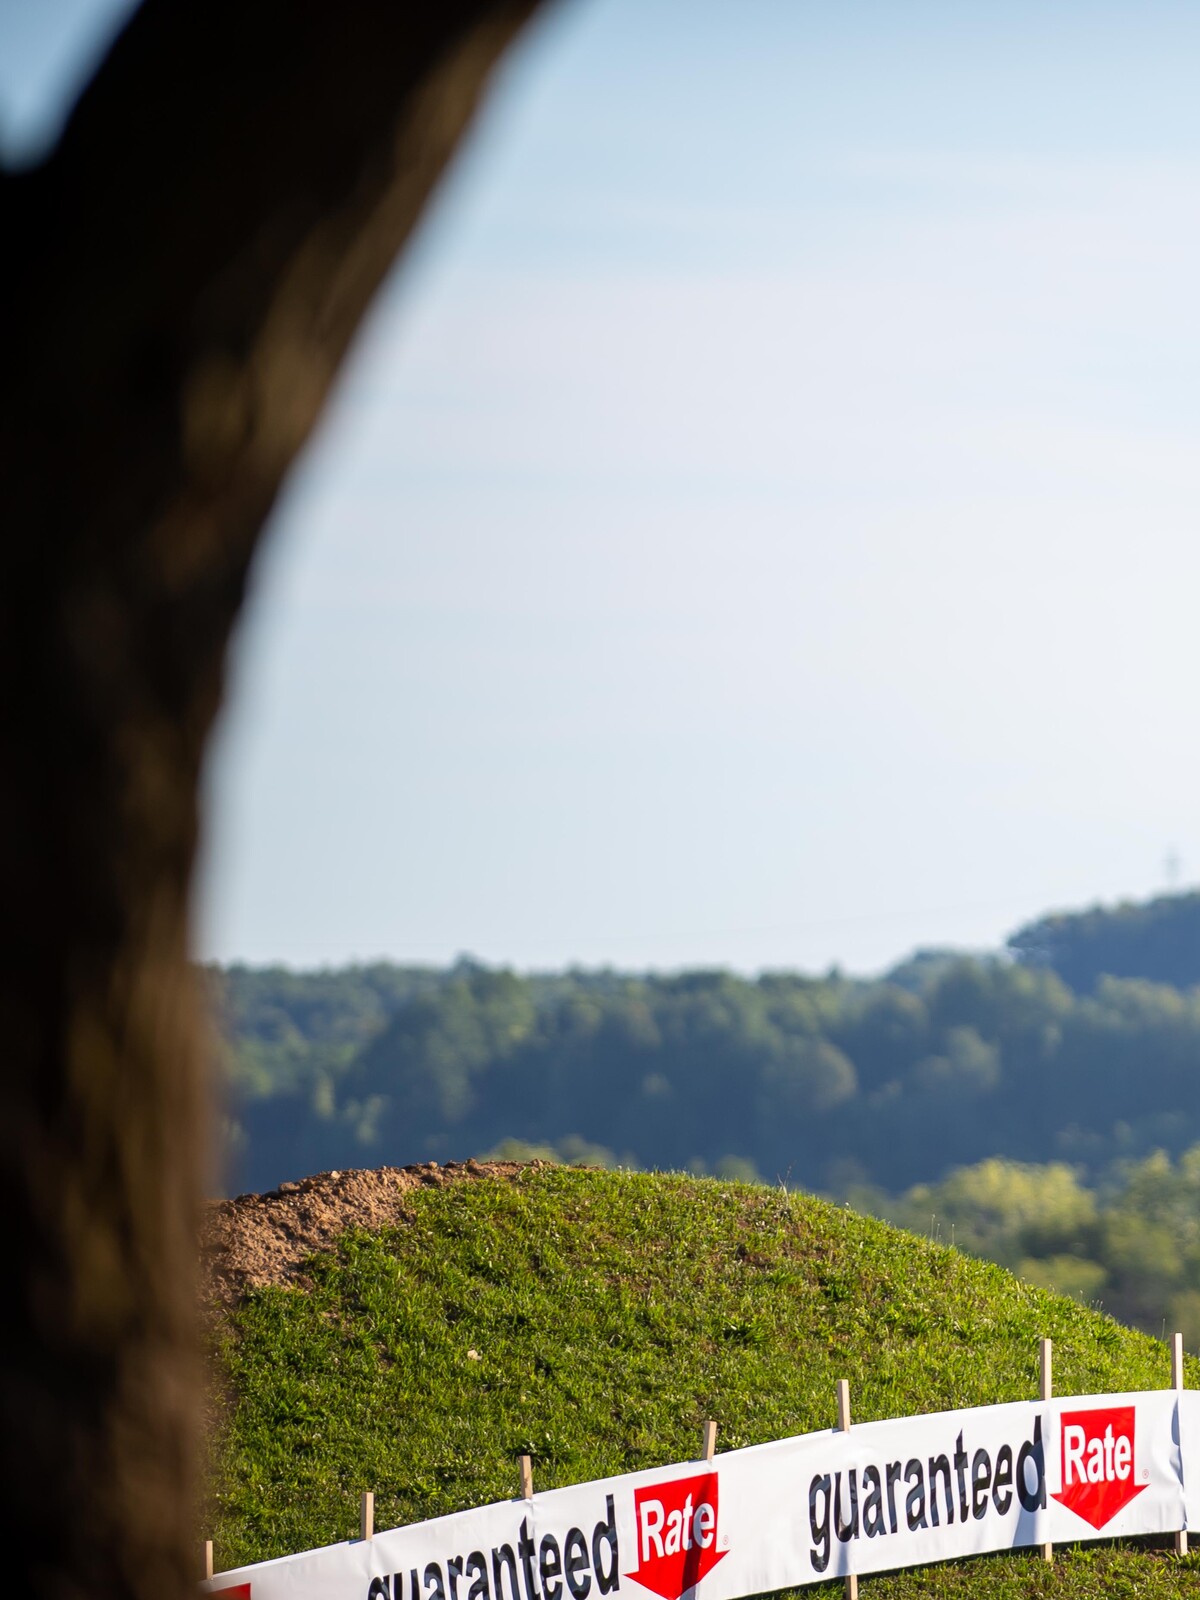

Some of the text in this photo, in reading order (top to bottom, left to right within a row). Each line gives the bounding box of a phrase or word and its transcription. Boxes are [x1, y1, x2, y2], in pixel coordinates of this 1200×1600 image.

[368, 1493, 715, 1600] aranteed Rate
[809, 1415, 1132, 1573] guaranteed Rate
